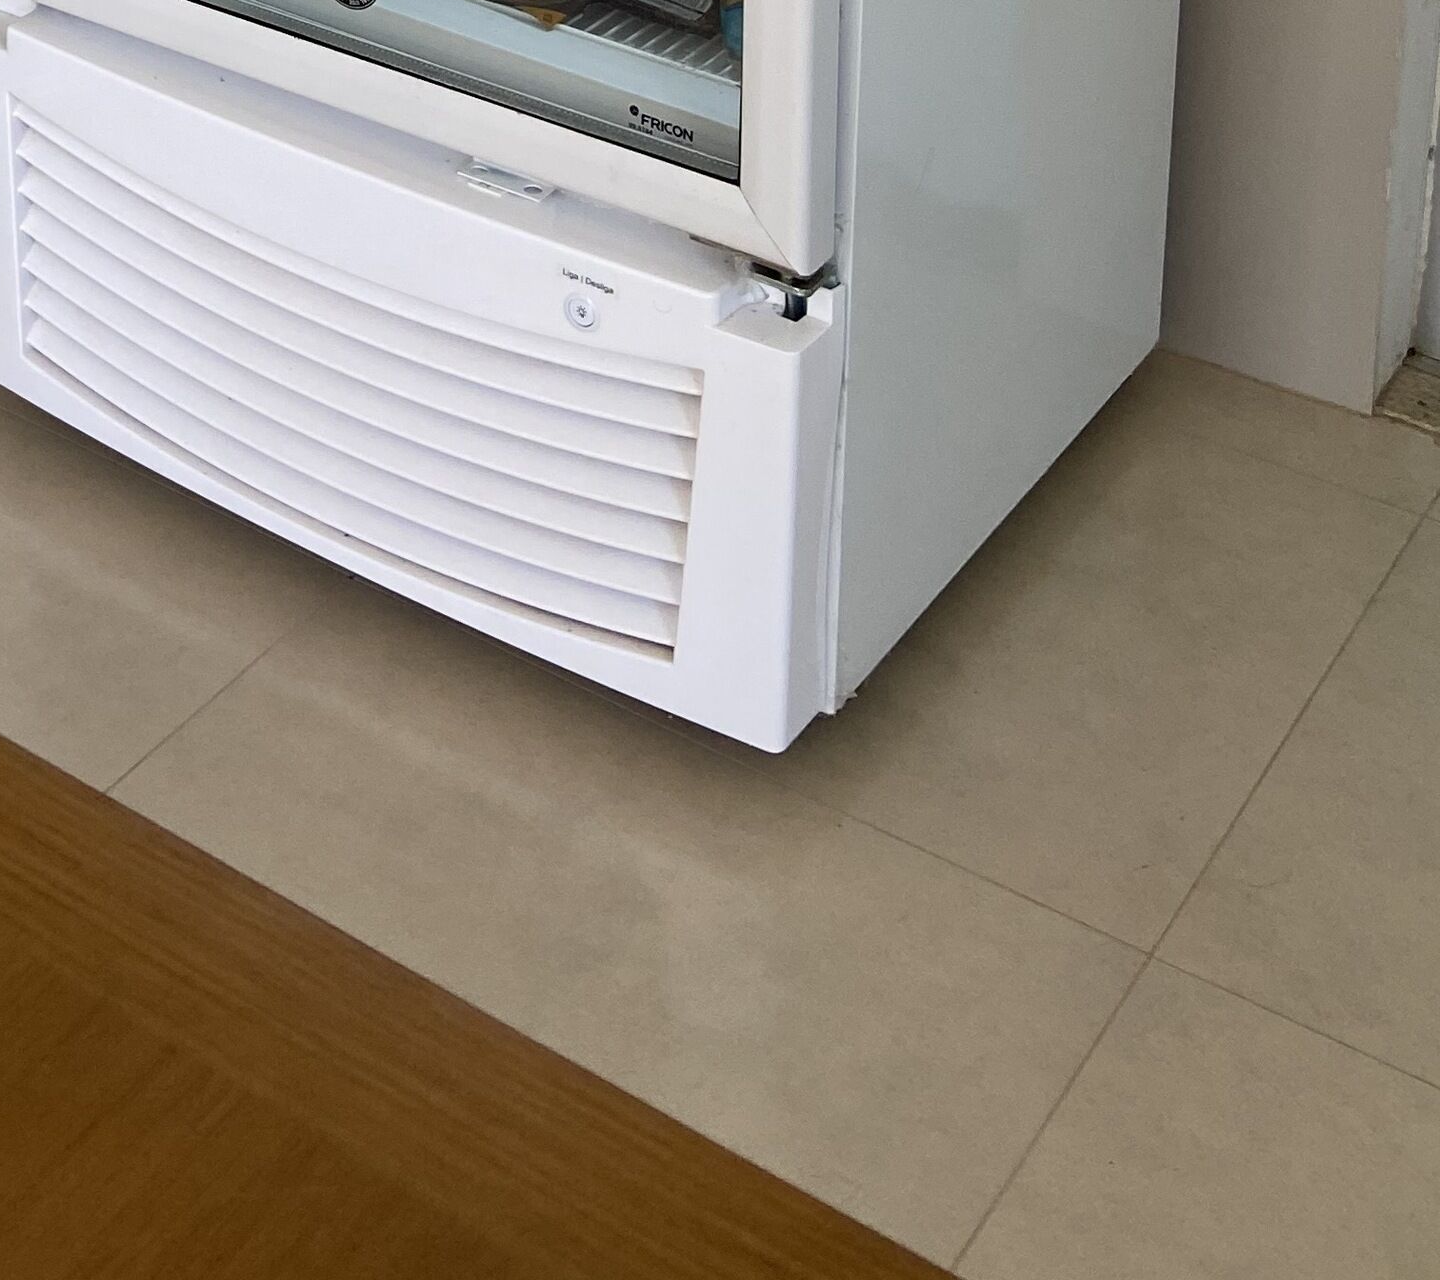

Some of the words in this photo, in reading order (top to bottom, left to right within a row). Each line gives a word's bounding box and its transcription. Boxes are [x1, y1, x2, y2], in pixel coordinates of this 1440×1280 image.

[641, 113, 694, 143] FRICON
[562, 267, 579, 280] Liga
[585, 277, 614, 294] Desliga
